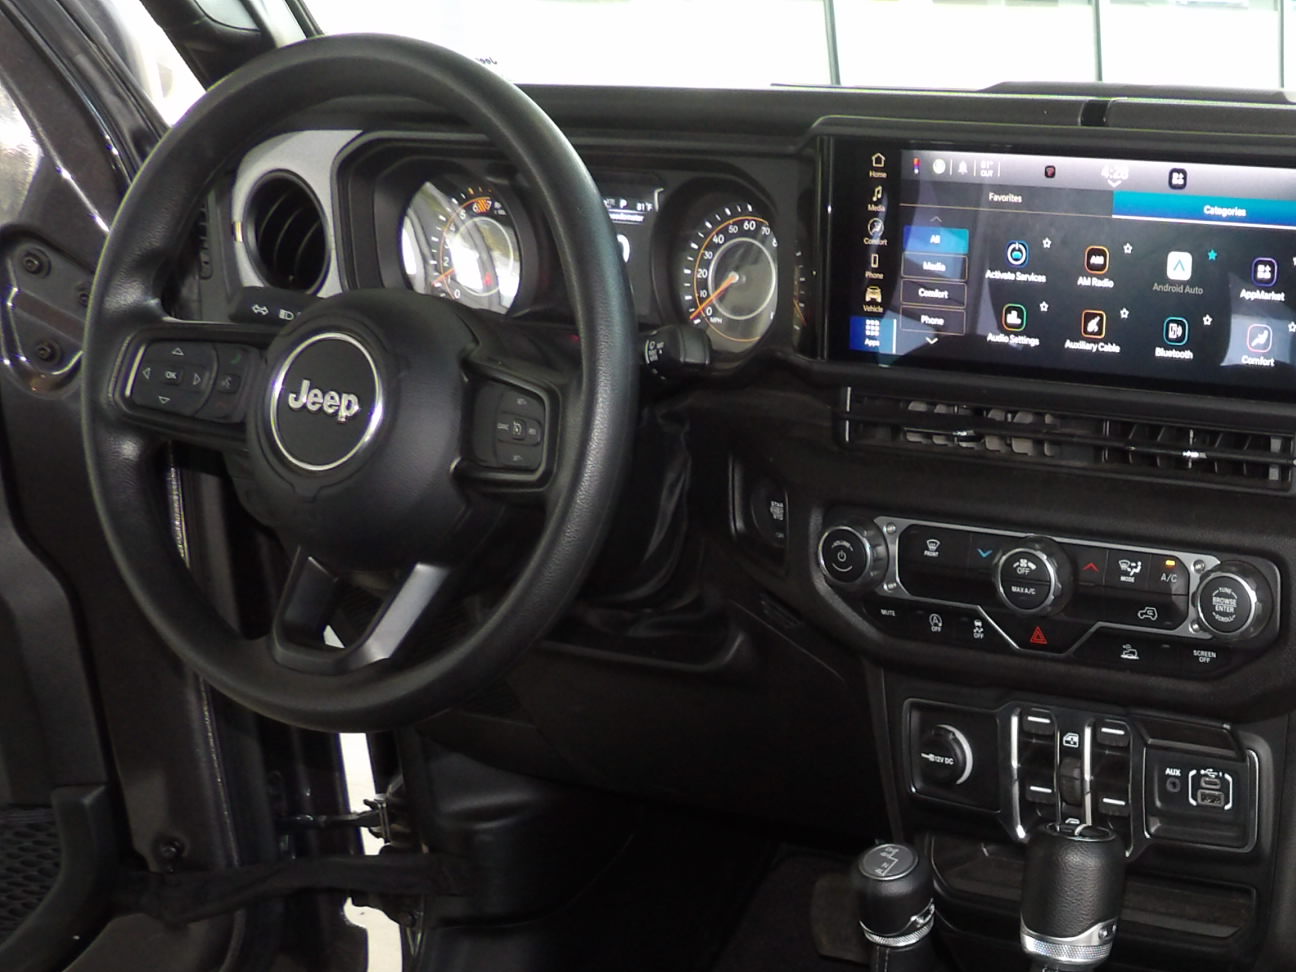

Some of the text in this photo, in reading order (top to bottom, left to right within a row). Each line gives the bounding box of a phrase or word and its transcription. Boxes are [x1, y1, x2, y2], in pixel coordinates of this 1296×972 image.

[988, 191, 1023, 204] Favorites
[867, 204, 886, 212] Media
[1203, 204, 1248, 218] Categories
[728, 224, 739, 234] 50
[743, 220, 756, 231] 60
[761, 226, 771, 236] 70
[712, 234, 725, 244] 40
[863, 237, 888, 247] Comfort
[703, 251, 713, 260] 30
[922, 261, 947, 272] Media
[697, 268, 708, 278] 20
[864, 270, 884, 280] Phone
[985, 269, 1047, 283] Activate Services
[1091, 277, 1115, 288] Radio
[699, 289, 708, 298] 10
[918, 287, 949, 300] Comfort
[1152, 282, 1204, 296] Android Auto
[1240, 288, 1286, 302] AppMarket
[705, 306, 713, 316] 0
[863, 304, 884, 313] Vehicle
[920, 314, 945, 326] Phone
[864, 338, 881, 348] Apps
[986, 332, 1041, 348] Audio Settings
[1064, 339, 1121, 353] Auxiliary Cable
[1154, 346, 1194, 360] Bluetooth
[1241, 355, 1276, 368] Comfort
[288, 378, 360, 422] Jeep
[1016, 566, 1031, 576] OFF
[1119, 575, 1136, 583] MODE
[1160, 572, 1178, 583] A/C
[1011, 585, 1037, 595] MAX A/C
[1212, 596, 1237, 606] BROWSE
[880, 608, 896, 617] MUTE
[1215, 604, 1235, 613] ENTER
[1193, 649, 1217, 659] SCREEN
[1199, 656, 1211, 664] OFF
[944, 757, 954, 765] DC
[1164, 767, 1182, 776] AUX
